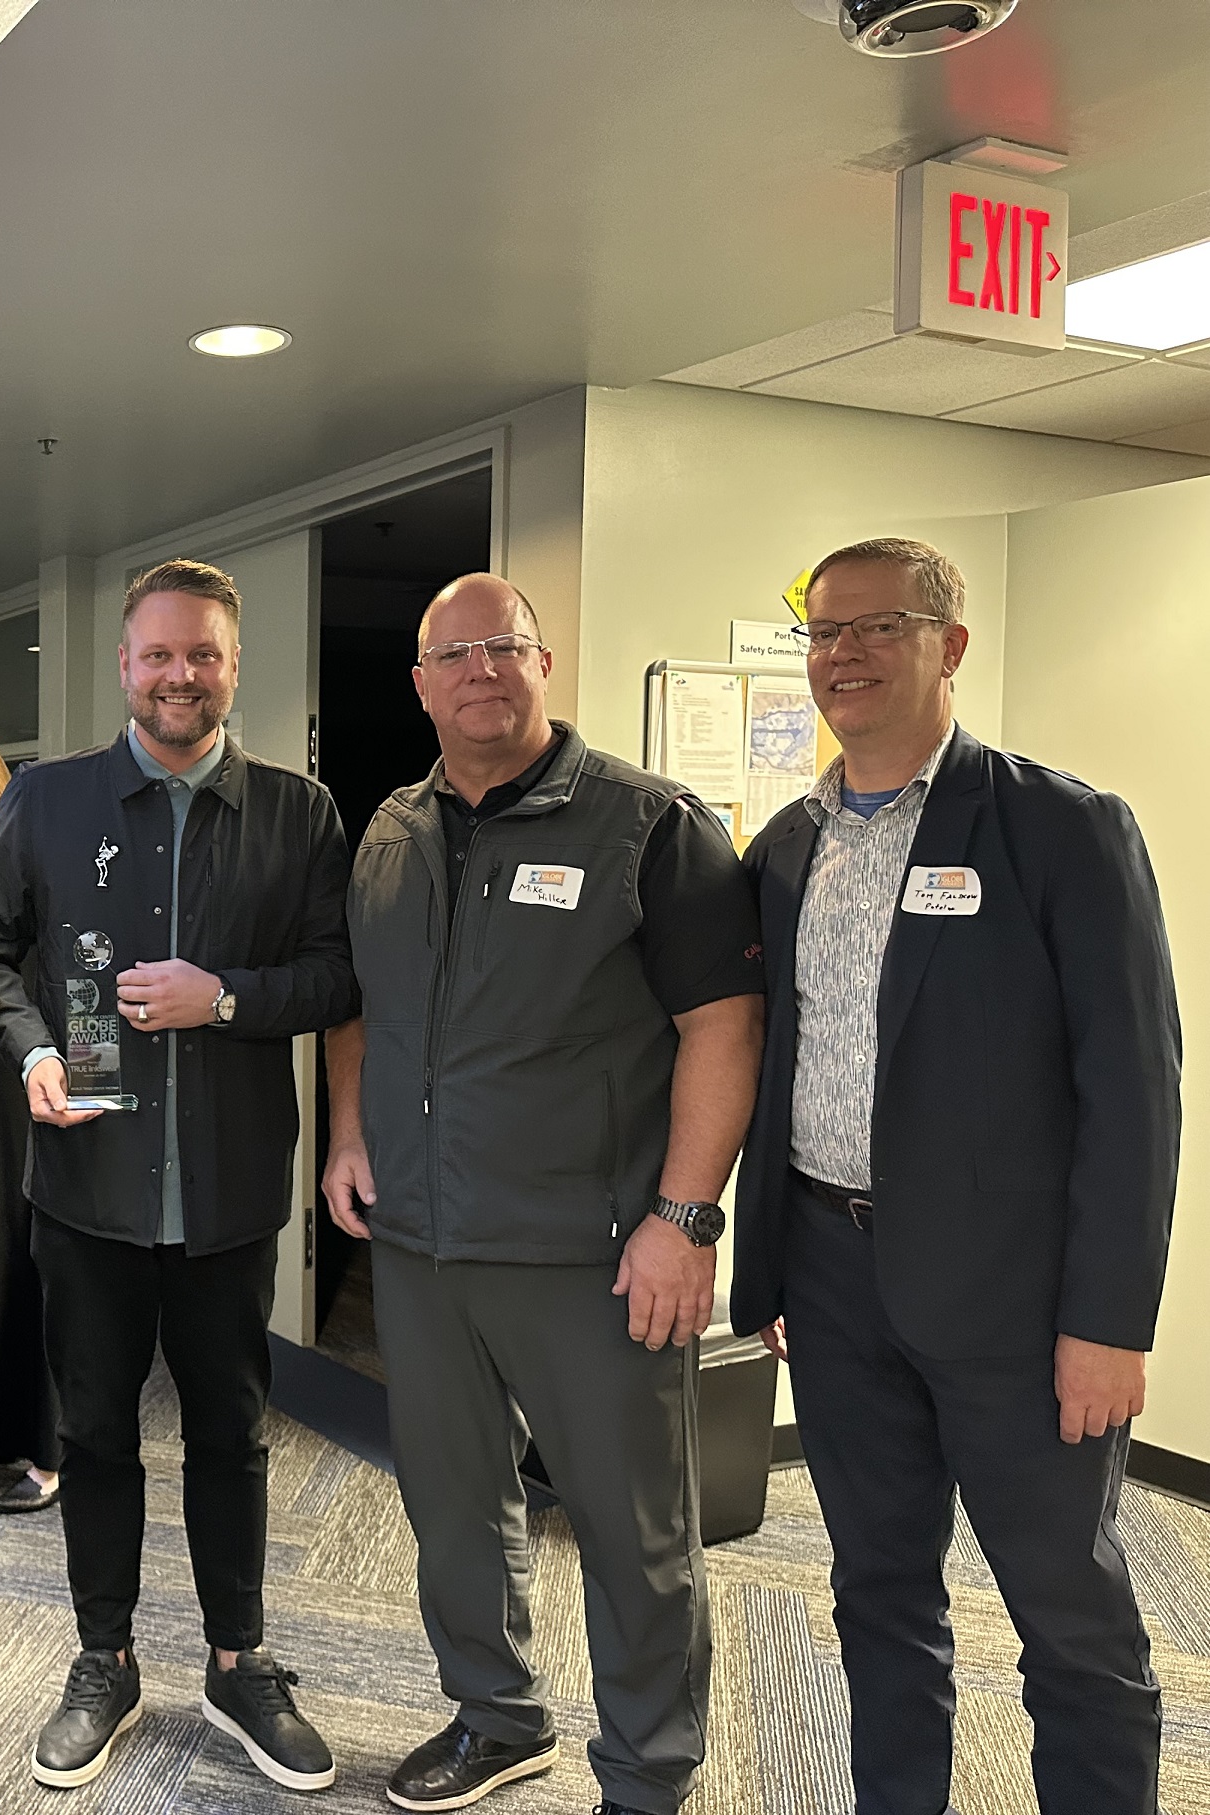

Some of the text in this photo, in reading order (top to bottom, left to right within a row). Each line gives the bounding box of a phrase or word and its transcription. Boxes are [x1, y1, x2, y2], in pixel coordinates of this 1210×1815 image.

[947, 191, 1050, 319] EXIT
[774, 631, 791, 640] Port
[740, 644, 765, 656] Safety
[68, 1020, 117, 1033] GLOBE
[70, 1033, 117, 1043] AWARD
[70, 1065, 88, 1073] TRUE
